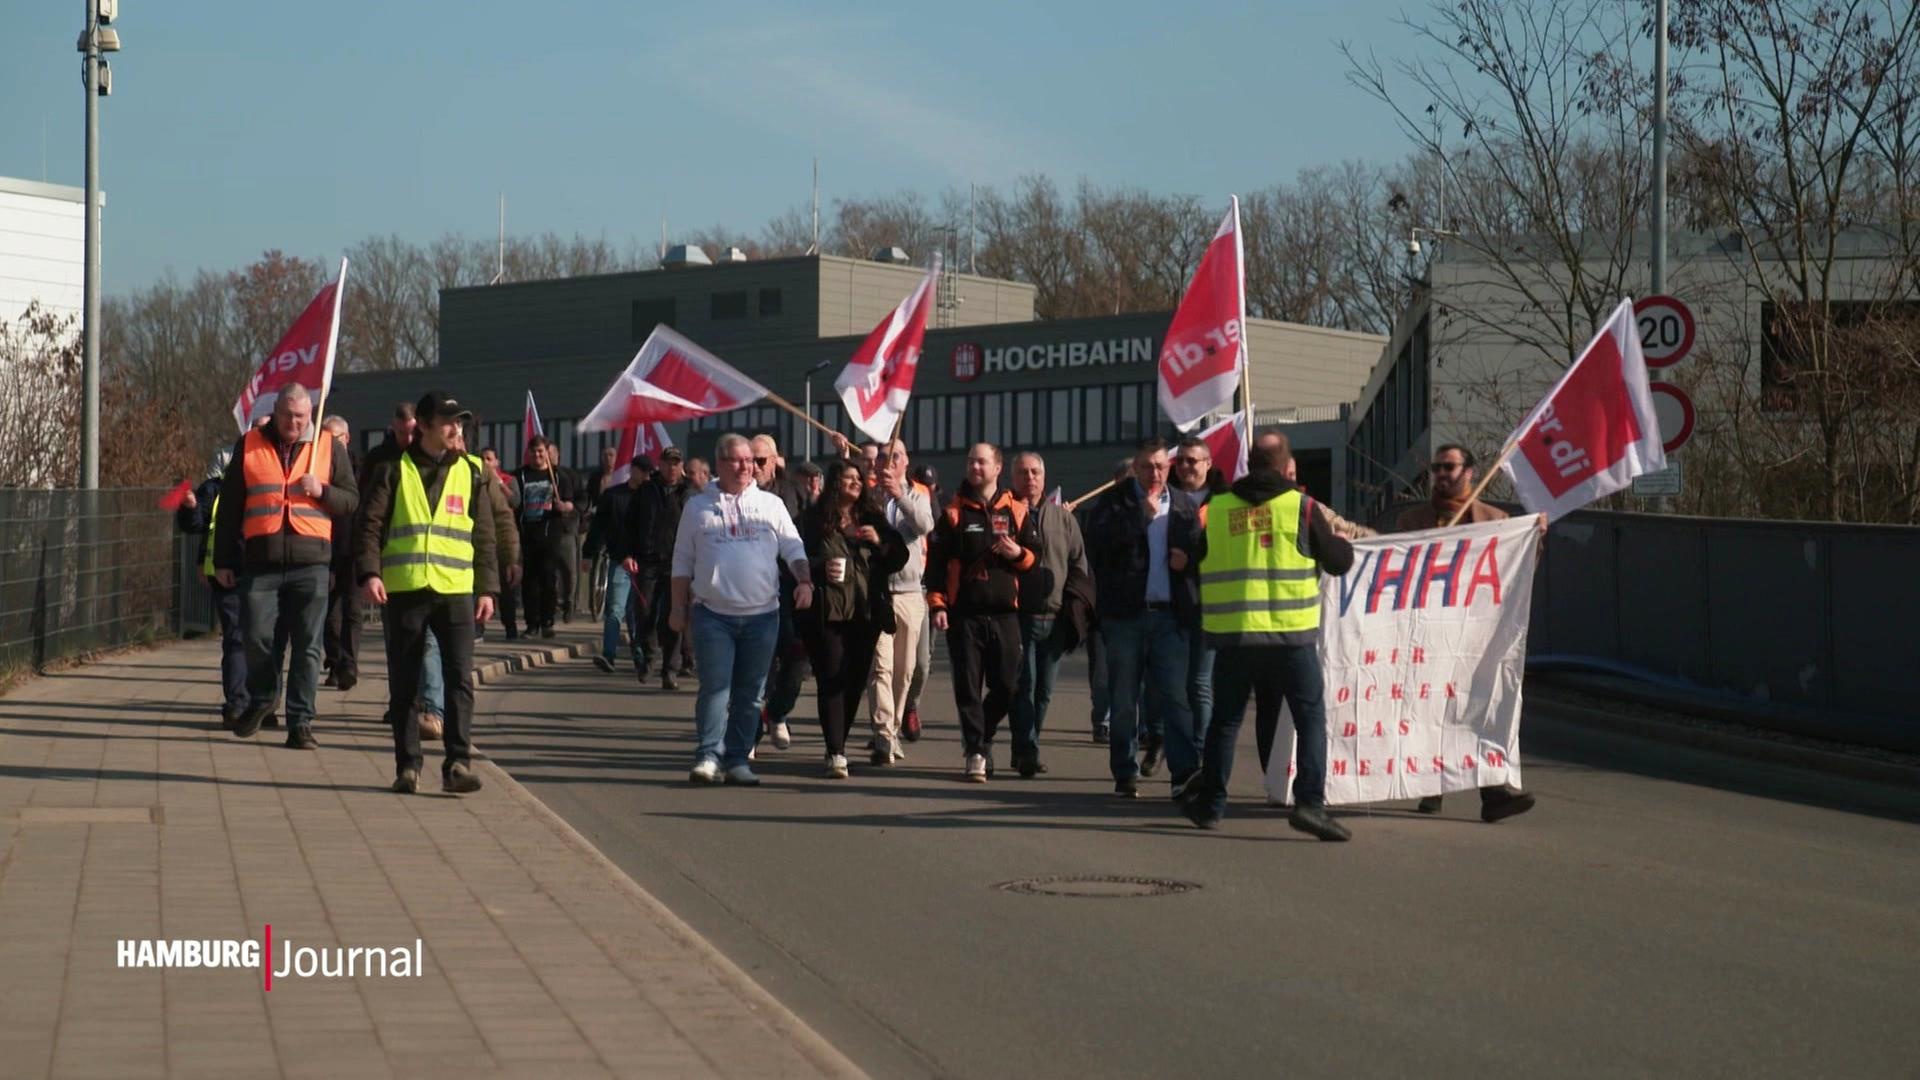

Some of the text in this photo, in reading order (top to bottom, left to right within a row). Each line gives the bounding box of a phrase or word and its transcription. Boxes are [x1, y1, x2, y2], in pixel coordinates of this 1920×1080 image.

[1640, 314, 1680, 348] 20
[984, 337, 1152, 372] HOCHBAHN
[1536, 402, 1590, 478] er.di
[1339, 536, 1502, 618] VHHA
[1364, 646, 1425, 665] WIR
[1337, 682, 1457, 703] OCKEN
[1343, 719, 1410, 737] DAS
